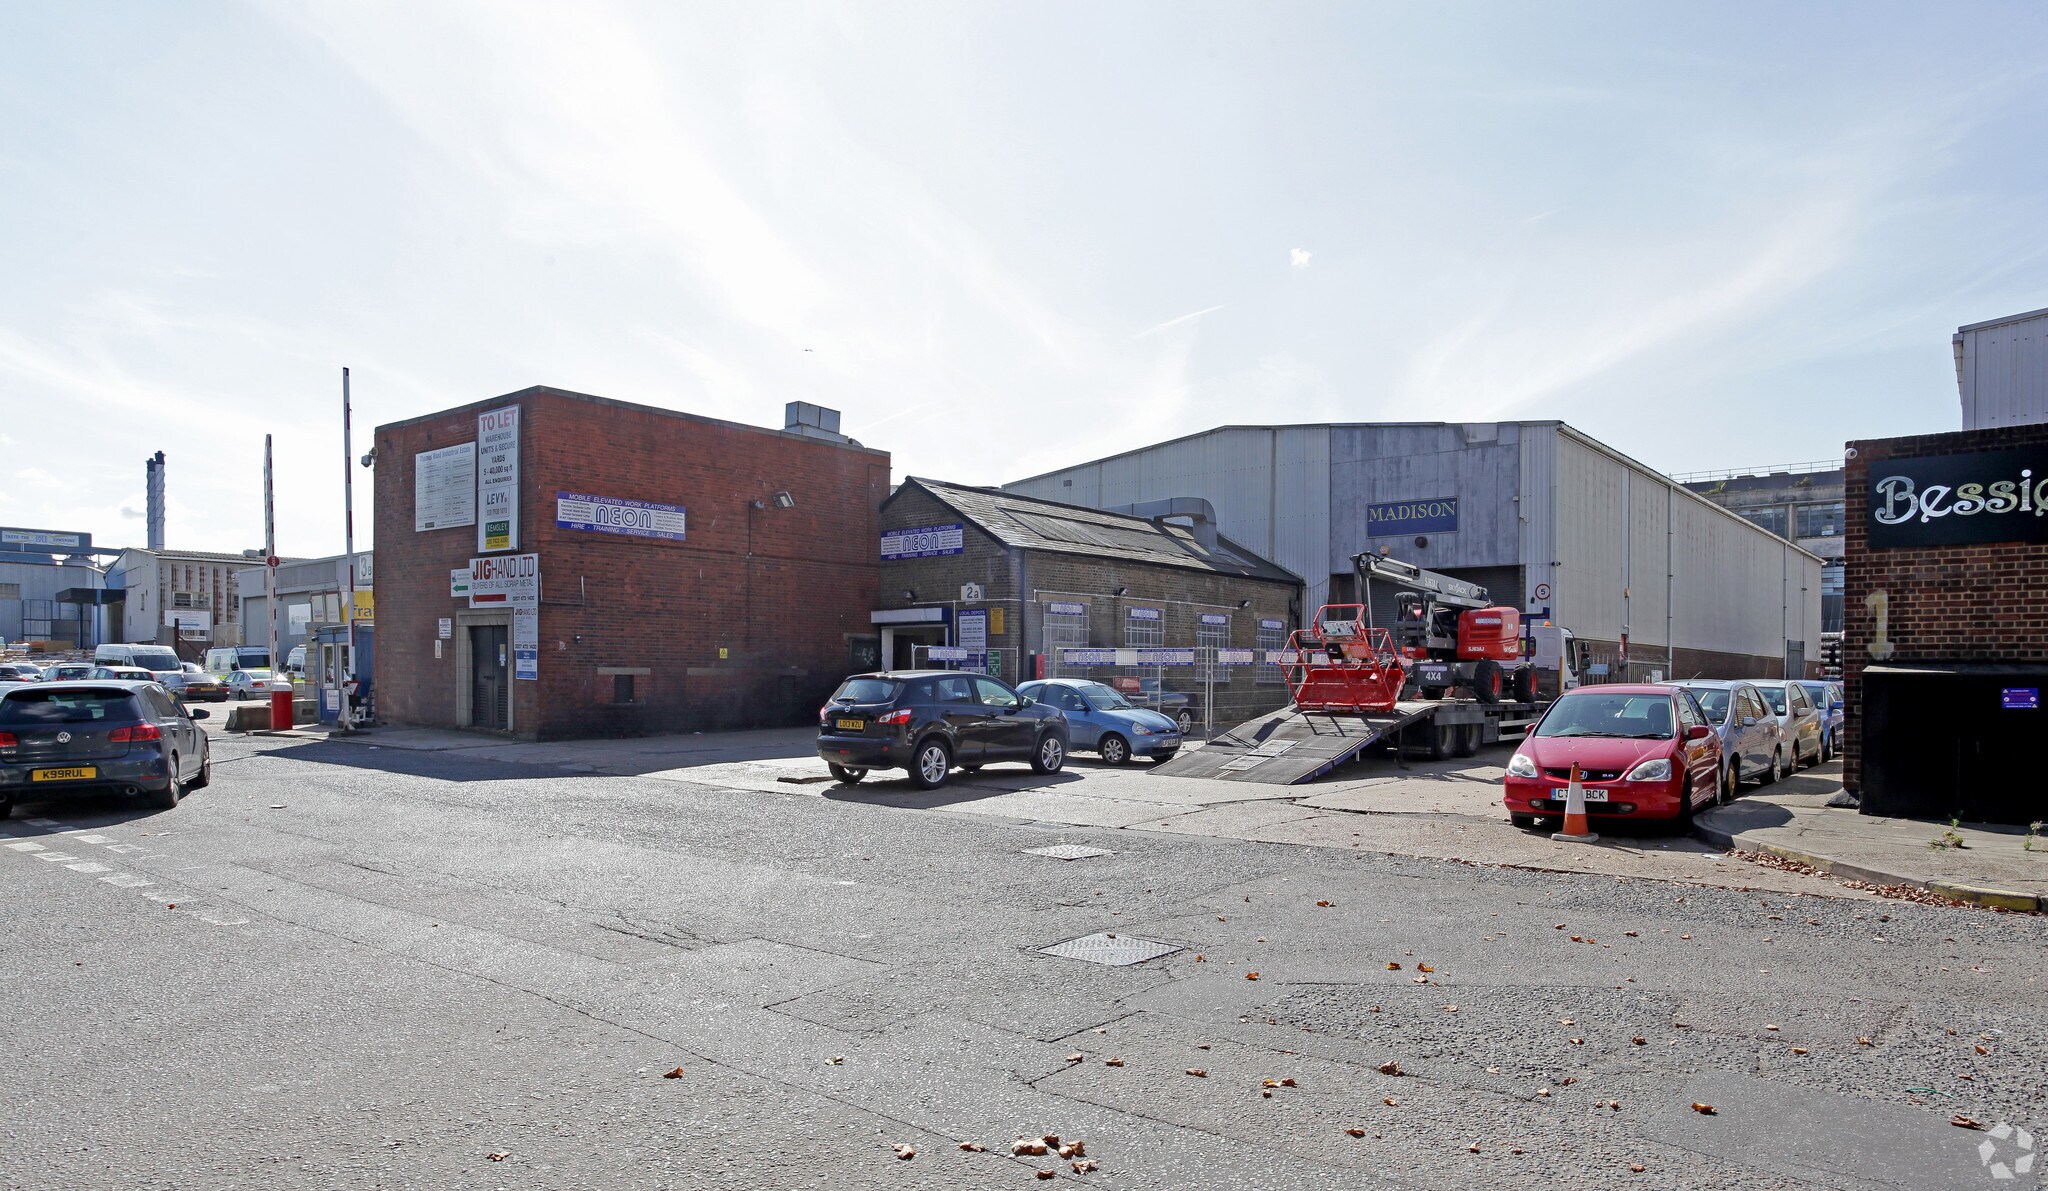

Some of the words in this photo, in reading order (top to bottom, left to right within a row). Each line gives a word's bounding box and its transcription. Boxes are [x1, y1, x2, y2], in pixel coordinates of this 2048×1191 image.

[481, 414, 494, 432] TO
[497, 409, 516, 428] LET
[485, 431, 511, 443] WAREHOUSE
[481, 446, 494, 454] UNITS
[499, 441, 515, 451] SECURE
[491, 454, 505, 463] YARDS
[569, 494, 590, 502] MOBILE
[593, 496, 623, 506] ELEVATED
[644, 502, 676, 512] PLATFORMS
[1368, 501, 1457, 522] MADISON
[593, 525, 619, 533] TRAINING
[626, 528, 650, 536] SERVICE
[472, 558, 516, 580] JIGHAND
[519, 557, 534, 577] LTD
[967, 587, 978, 598] 2a
[1865, 588, 1895, 660] 1
[43, 769, 86, 779] K99RUL
[1586, 790, 1605, 799] BCK
